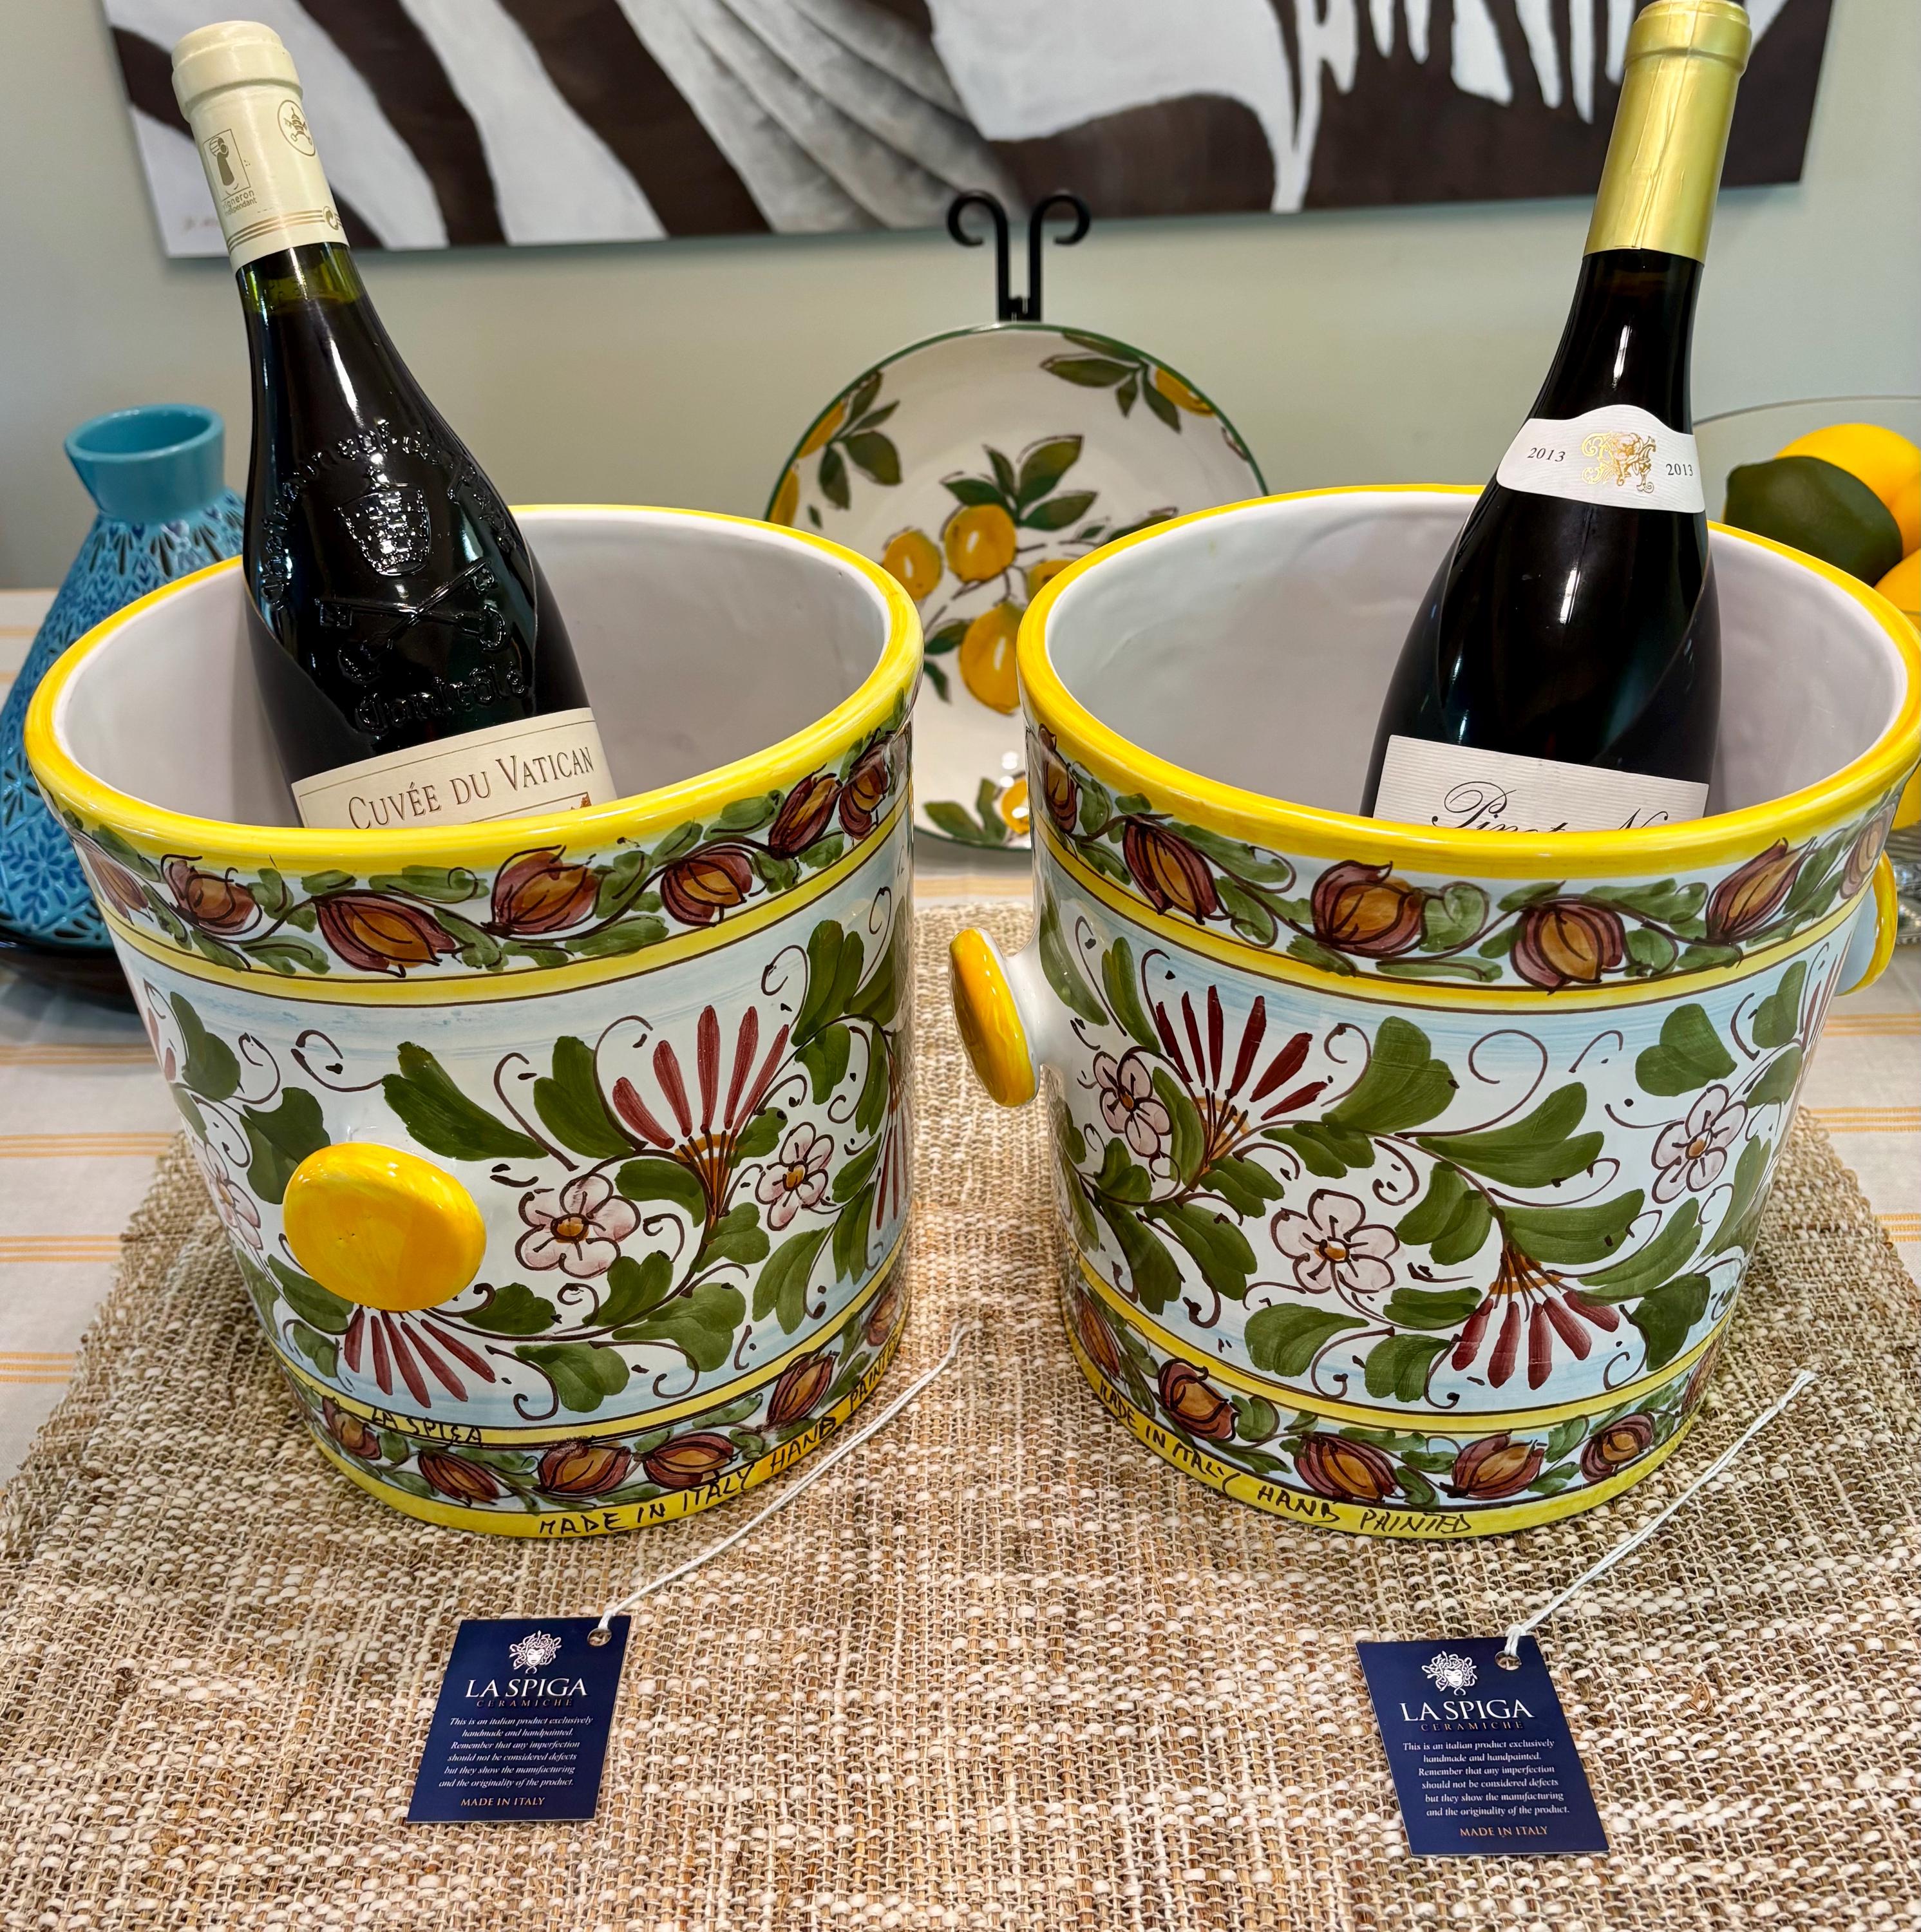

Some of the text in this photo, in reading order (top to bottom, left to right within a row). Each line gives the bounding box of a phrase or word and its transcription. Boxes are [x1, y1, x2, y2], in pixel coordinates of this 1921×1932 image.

[1527, 447, 1566, 462] 2013
[1665, 463, 1694, 477] 2013
[348, 746, 594, 830] CUVÉE DU VATICAN
[1432, 781, 1569, 833] Pin
[372, 1407, 398, 1429] LA
[540, 1512, 629, 1535] MADE
[638, 1502, 665, 1522] IN
[683, 1463, 755, 1511] ITALY
[771, 1416, 837, 1473] HAND
[1145, 1425, 1166, 1448] IN
[1172, 1442, 1241, 1493] ITALY
[1359, 1509, 1472, 1533] PAINTED
[465, 1678, 588, 1697] LA SPIGA
[477, 1699, 573, 1707] CERAMICHE
[1399, 1699, 1535, 1721] LA SPIGA
[516, 1716, 548, 1727] product
[549, 1716, 593, 1725] exclusively
[1421, 1721, 1524, 1731] CERAMICHE
[462, 1728, 504, 1737] handmade
[451, 1741, 494, 1749] Remember
[529, 1740, 580, 1750] imperfection
[1475, 1740, 1506, 1750] product
[1509, 1739, 1555, 1748] exclusively
[447, 1753, 477, 1761] should
[503, 1752, 549, 1761] considered
[549, 1752, 578, 1762] defects
[1423, 1754, 1466, 1763] handmade
[1469, 1753, 1485, 1761] and
[444, 1766, 459, 1774] but
[459, 1766, 477, 1776] they
[501, 1765, 515, 1774] the
[515, 1765, 576, 1775] manufacturing
[1419, 1767, 1463, 1776] Remember
[1465, 1766, 1482, 1775] that
[1502, 1765, 1555, 1776] imperfection
[439, 1779, 457, 1787] and
[471, 1778, 515, 1788] originality
[515, 1778, 527, 1788] of
[1422, 1780, 1450, 1789] should
[1468, 1779, 1479, 1788] be
[1481, 1778, 1527, 1788] considered
[1529, 1778, 1559, 1788] defects
[460, 1797, 545, 1806] MADE IN ITALY
[1425, 1792, 1564, 1804] but they show the manufacturing
[1426, 1804, 1570, 1817] and the originality of the product.
[1459, 1825, 1548, 1837] MADE IN ITALY
